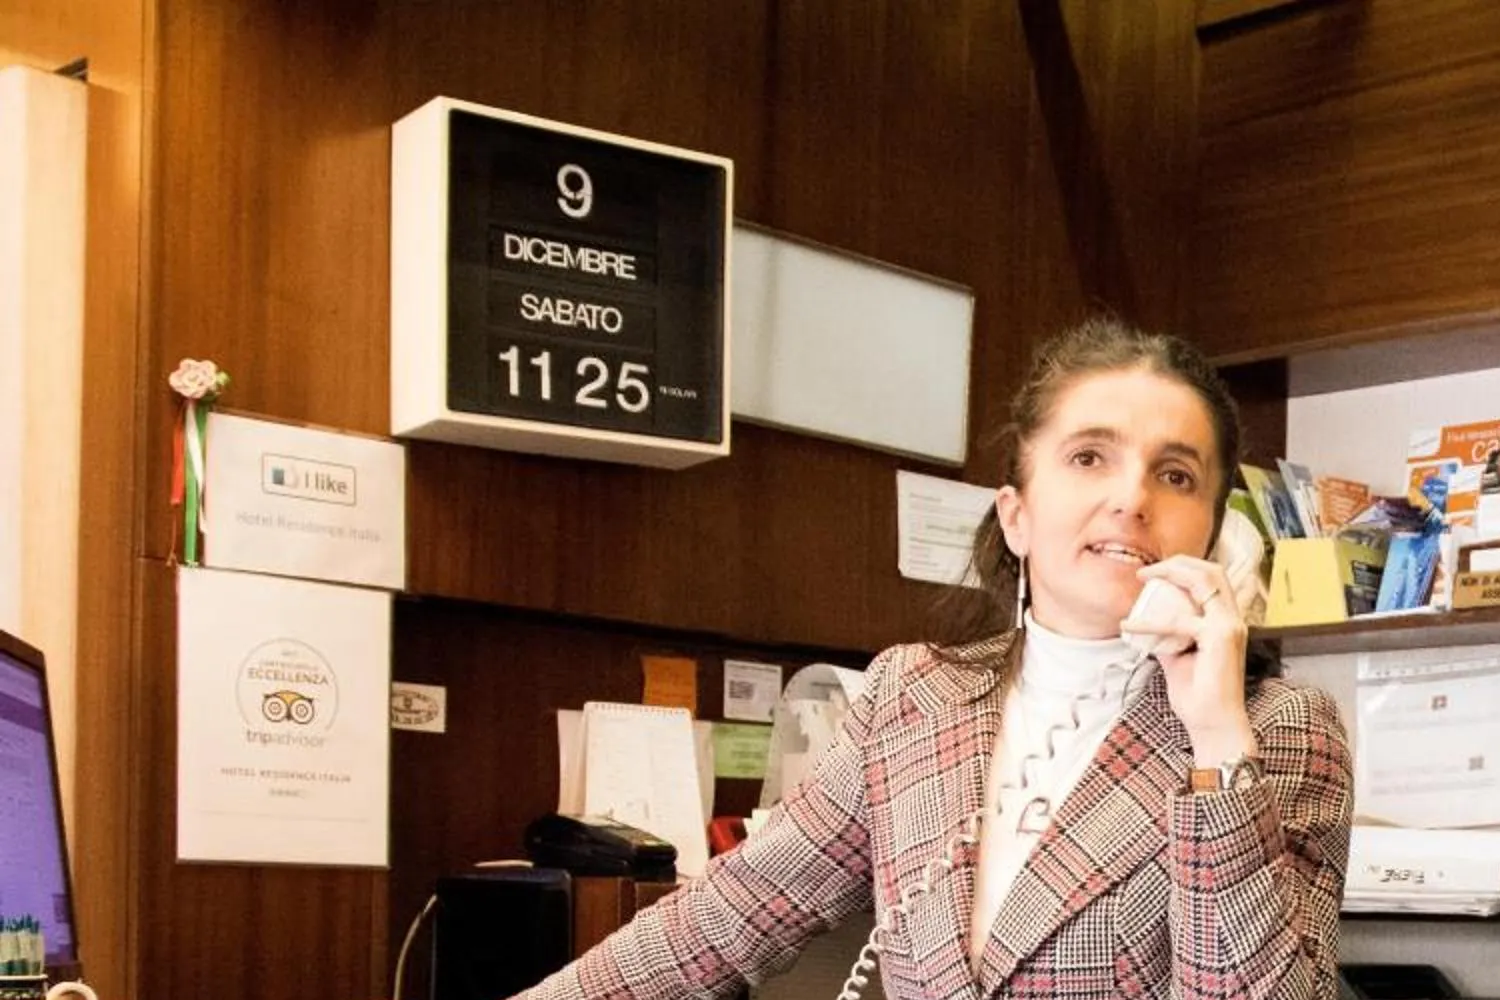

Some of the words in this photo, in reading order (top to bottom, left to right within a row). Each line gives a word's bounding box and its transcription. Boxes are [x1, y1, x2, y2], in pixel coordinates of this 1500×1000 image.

[557, 163, 594, 218] 9
[504, 233, 637, 280] DICEMBRE
[520, 293, 623, 333] SABATO
[499, 345, 551, 401] 11
[575, 356, 650, 412] 25
[304, 470, 309, 488] I
[315, 472, 348, 494] like
[248, 668, 329, 686] ECCELLENZA
